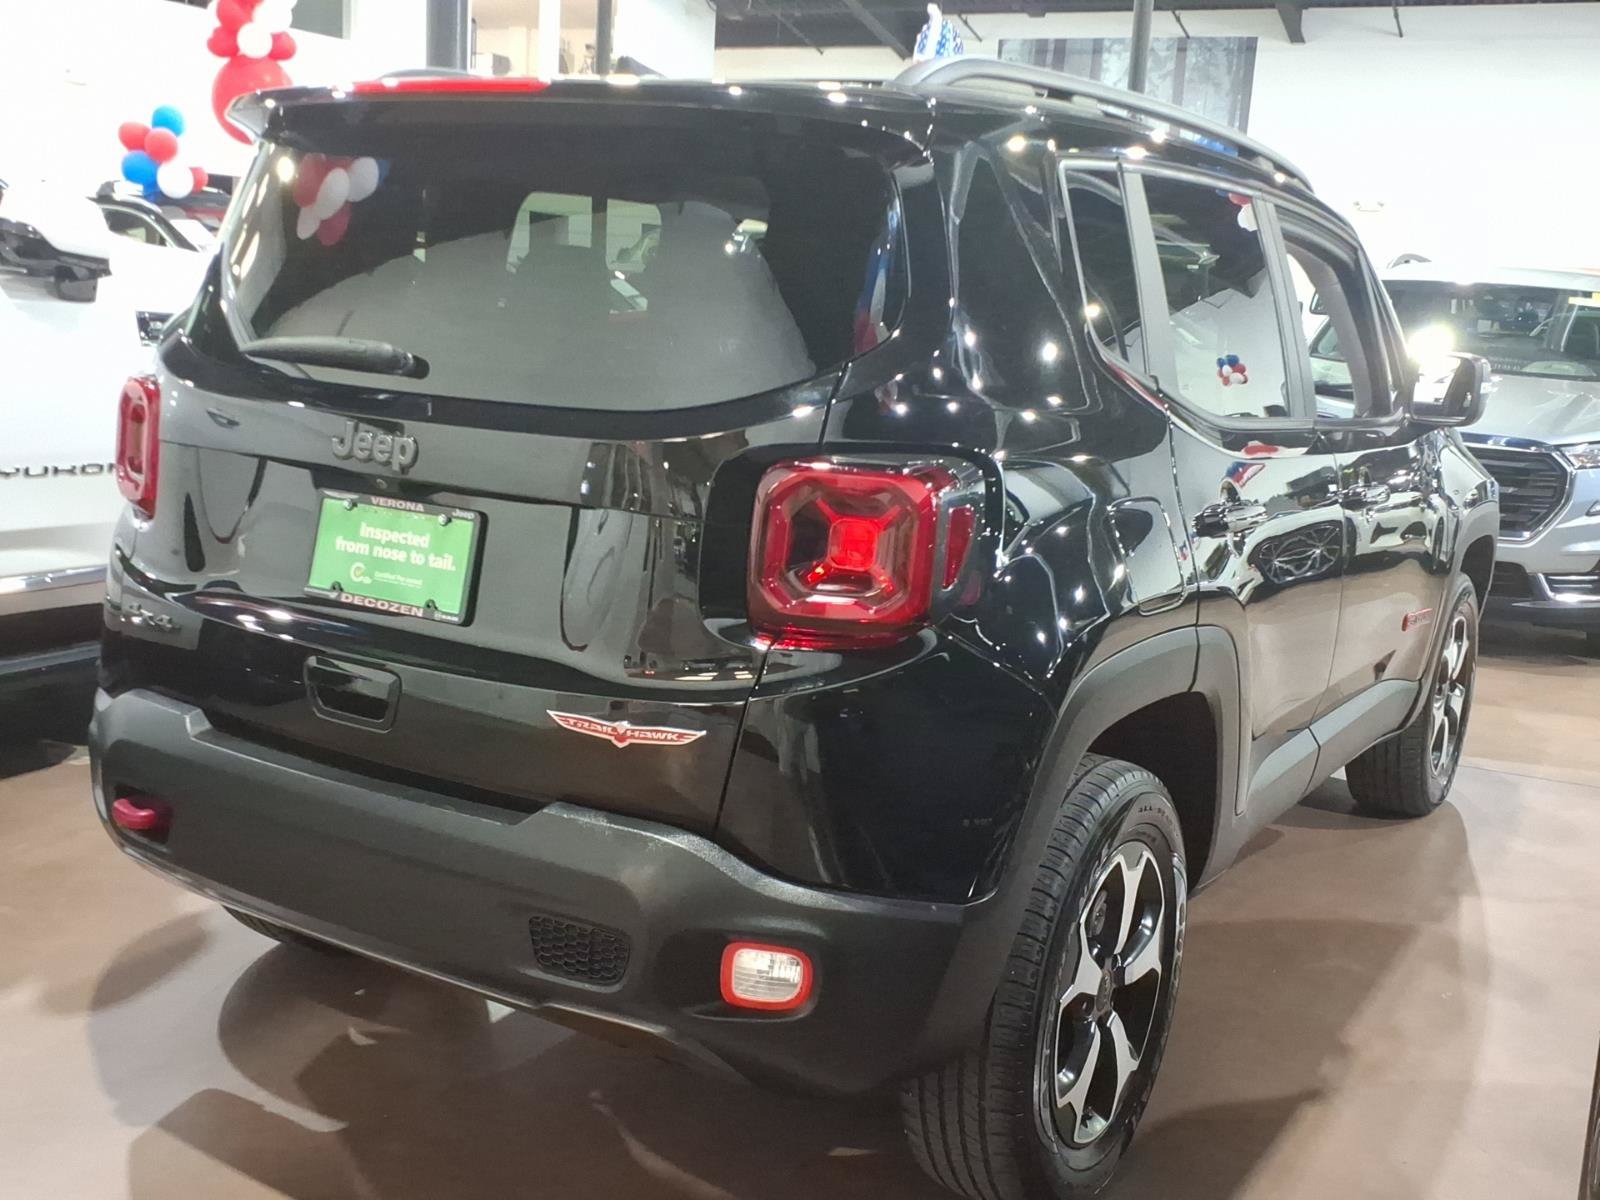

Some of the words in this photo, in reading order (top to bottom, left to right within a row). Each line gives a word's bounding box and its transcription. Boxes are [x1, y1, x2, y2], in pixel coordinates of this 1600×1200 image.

[332, 421, 417, 471] Jeep
[370, 496, 424, 512] VERONA
[359, 522, 430, 548] Inspected
[335, 535, 370, 555] from
[372, 544, 407, 562] nose
[410, 550, 425, 566] to
[428, 552, 456, 571] tail.
[340, 593, 424, 617] DECOZEN
